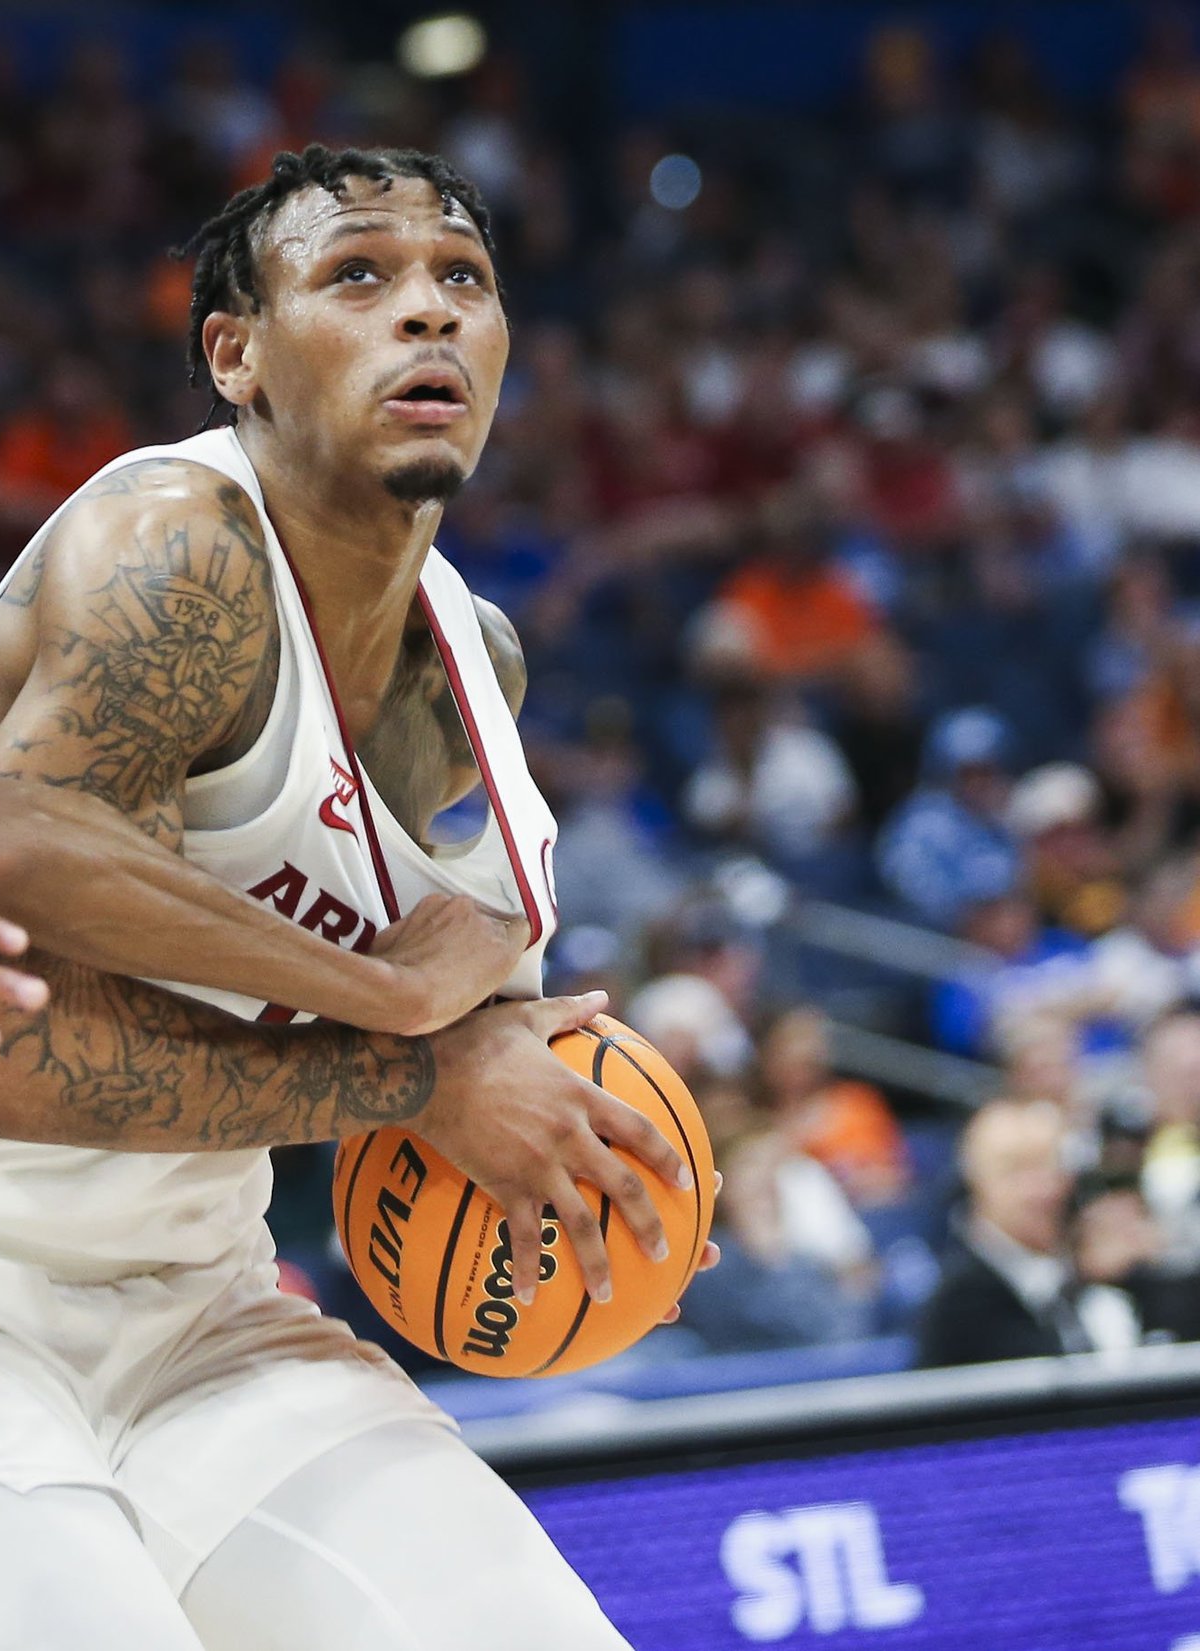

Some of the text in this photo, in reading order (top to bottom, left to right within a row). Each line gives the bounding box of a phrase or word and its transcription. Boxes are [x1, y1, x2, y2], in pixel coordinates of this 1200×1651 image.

[461, 1201, 493, 1309] INDOOR GAME BALL
[719, 1500, 926, 1642] STL
